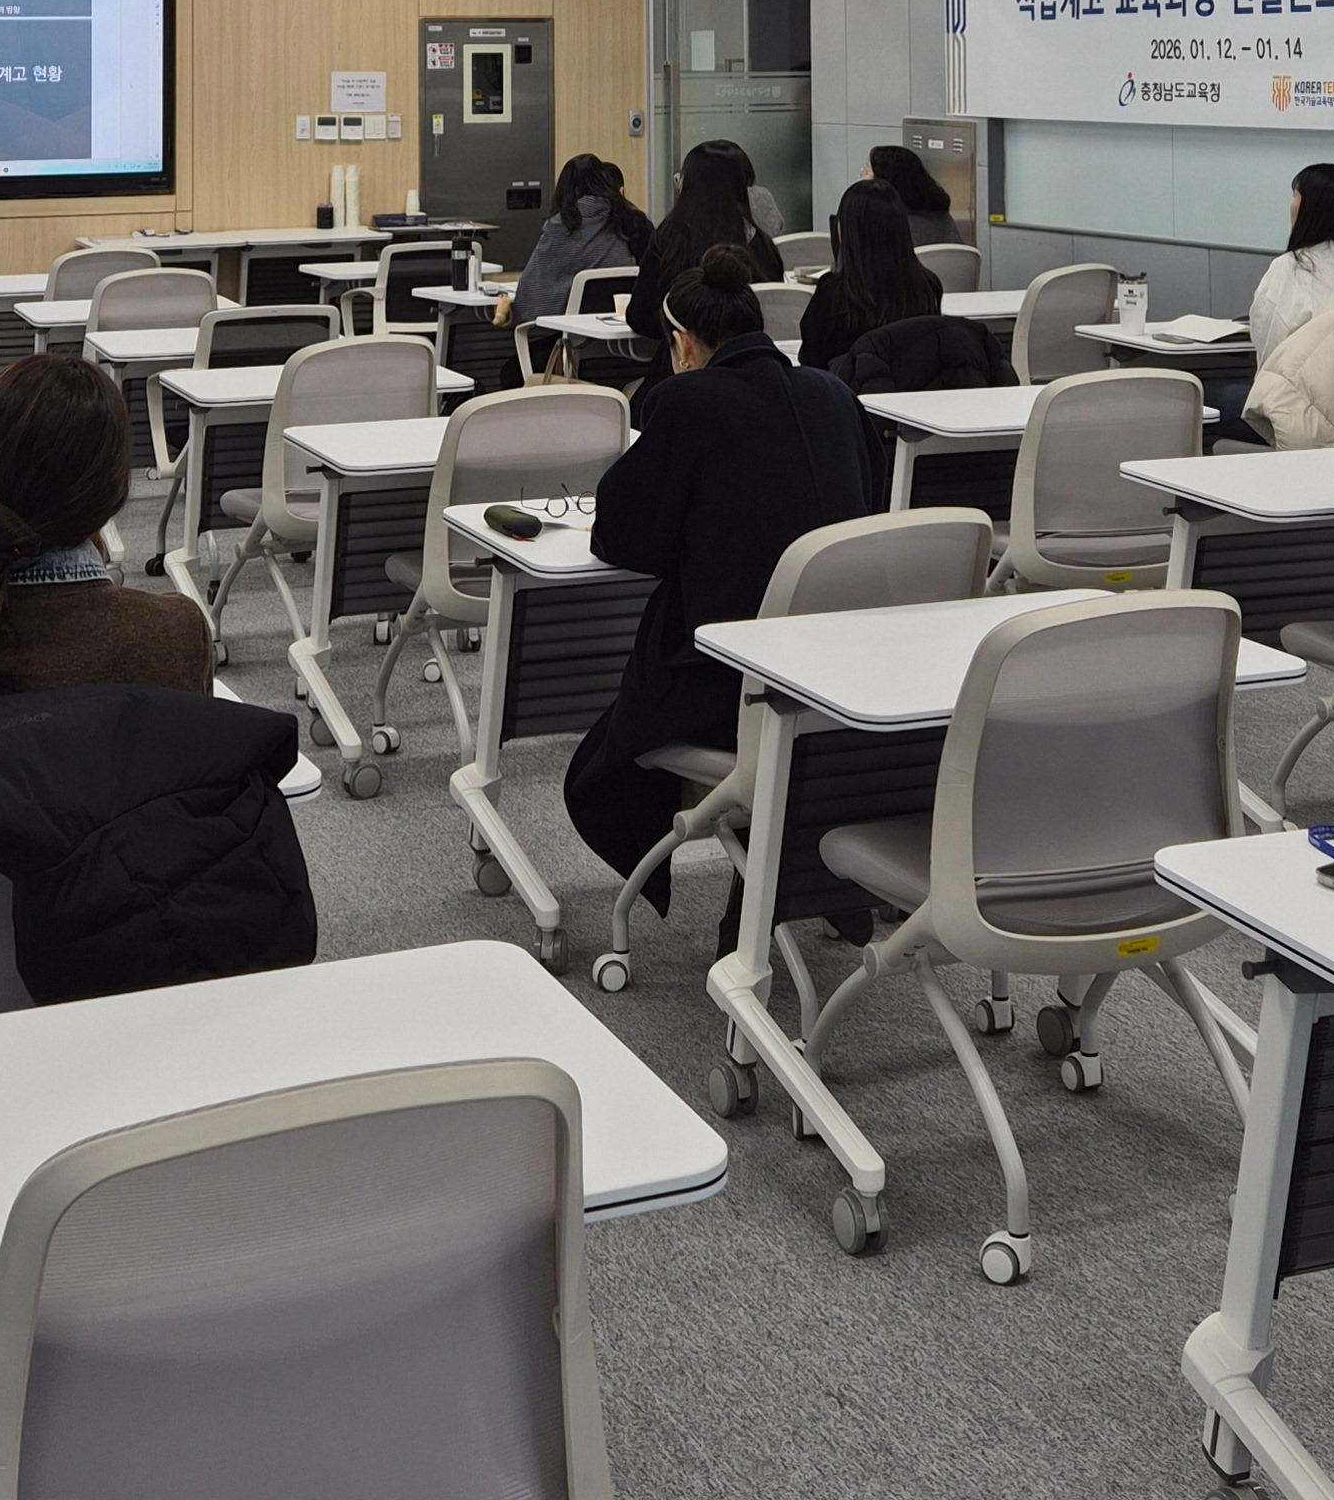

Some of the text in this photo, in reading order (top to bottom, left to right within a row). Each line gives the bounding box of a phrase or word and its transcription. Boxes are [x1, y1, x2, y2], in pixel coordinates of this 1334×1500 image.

[1150, 38, 1186, 61] 2026.
[1189, 37, 1211, 61] 01.
[1216, 37, 1238, 60] 12.
[1255, 37, 1279, 60] 01.
[1284, 36, 1303, 60] 14
[32, 65, 63, 83] 현황
[1140, 81, 1221, 103] 충청남도교육청
